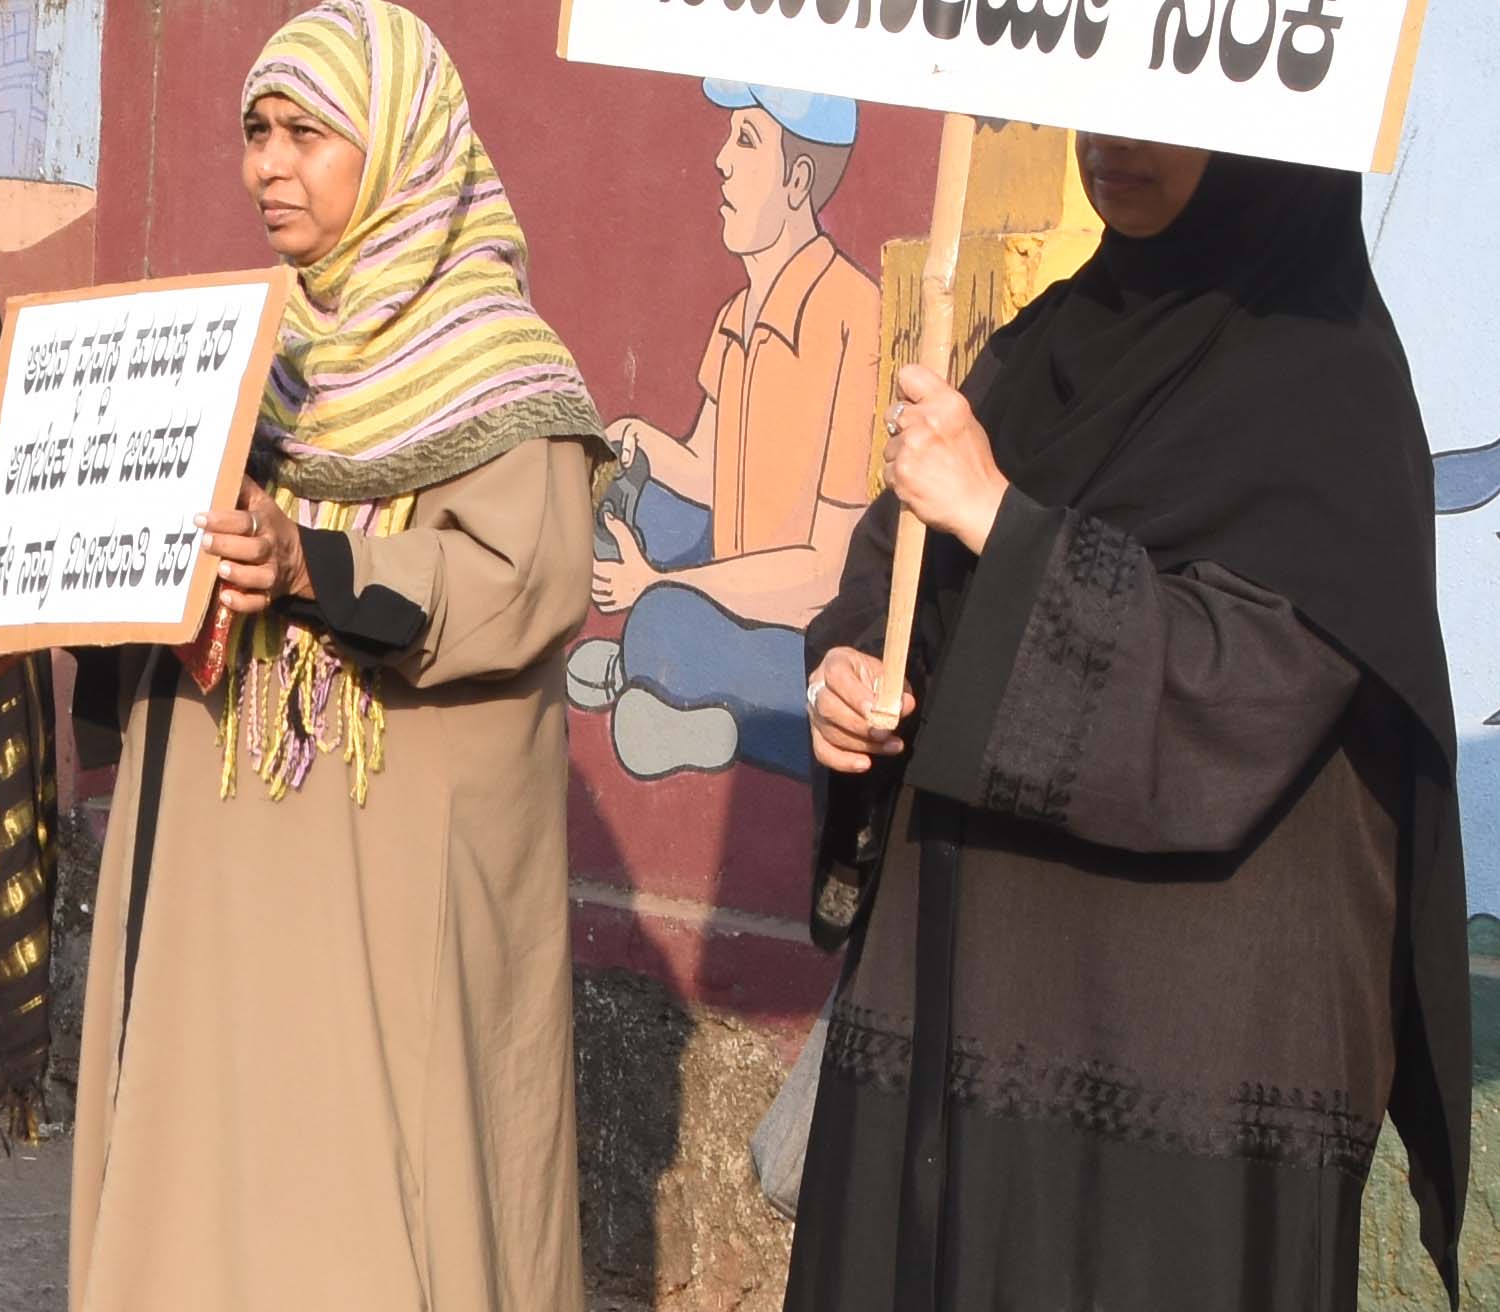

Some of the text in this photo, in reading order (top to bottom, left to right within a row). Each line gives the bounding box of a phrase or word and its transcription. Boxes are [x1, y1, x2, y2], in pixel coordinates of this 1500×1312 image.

[24, 328, 76, 395] ಆಳುವ
[127, 310, 197, 387] ಪುರುಷ
[197, 305, 241, 373] ಪರ
[5, 409, 203, 495] ಆಗಬೇಕು ಅದು ಜೀವಪರ
[17, 530, 60, 610] ನಾವು
[61, 523, 150, 590] ಮೀಸಲಾತಿ
[155, 516, 198, 586] ಪರ
